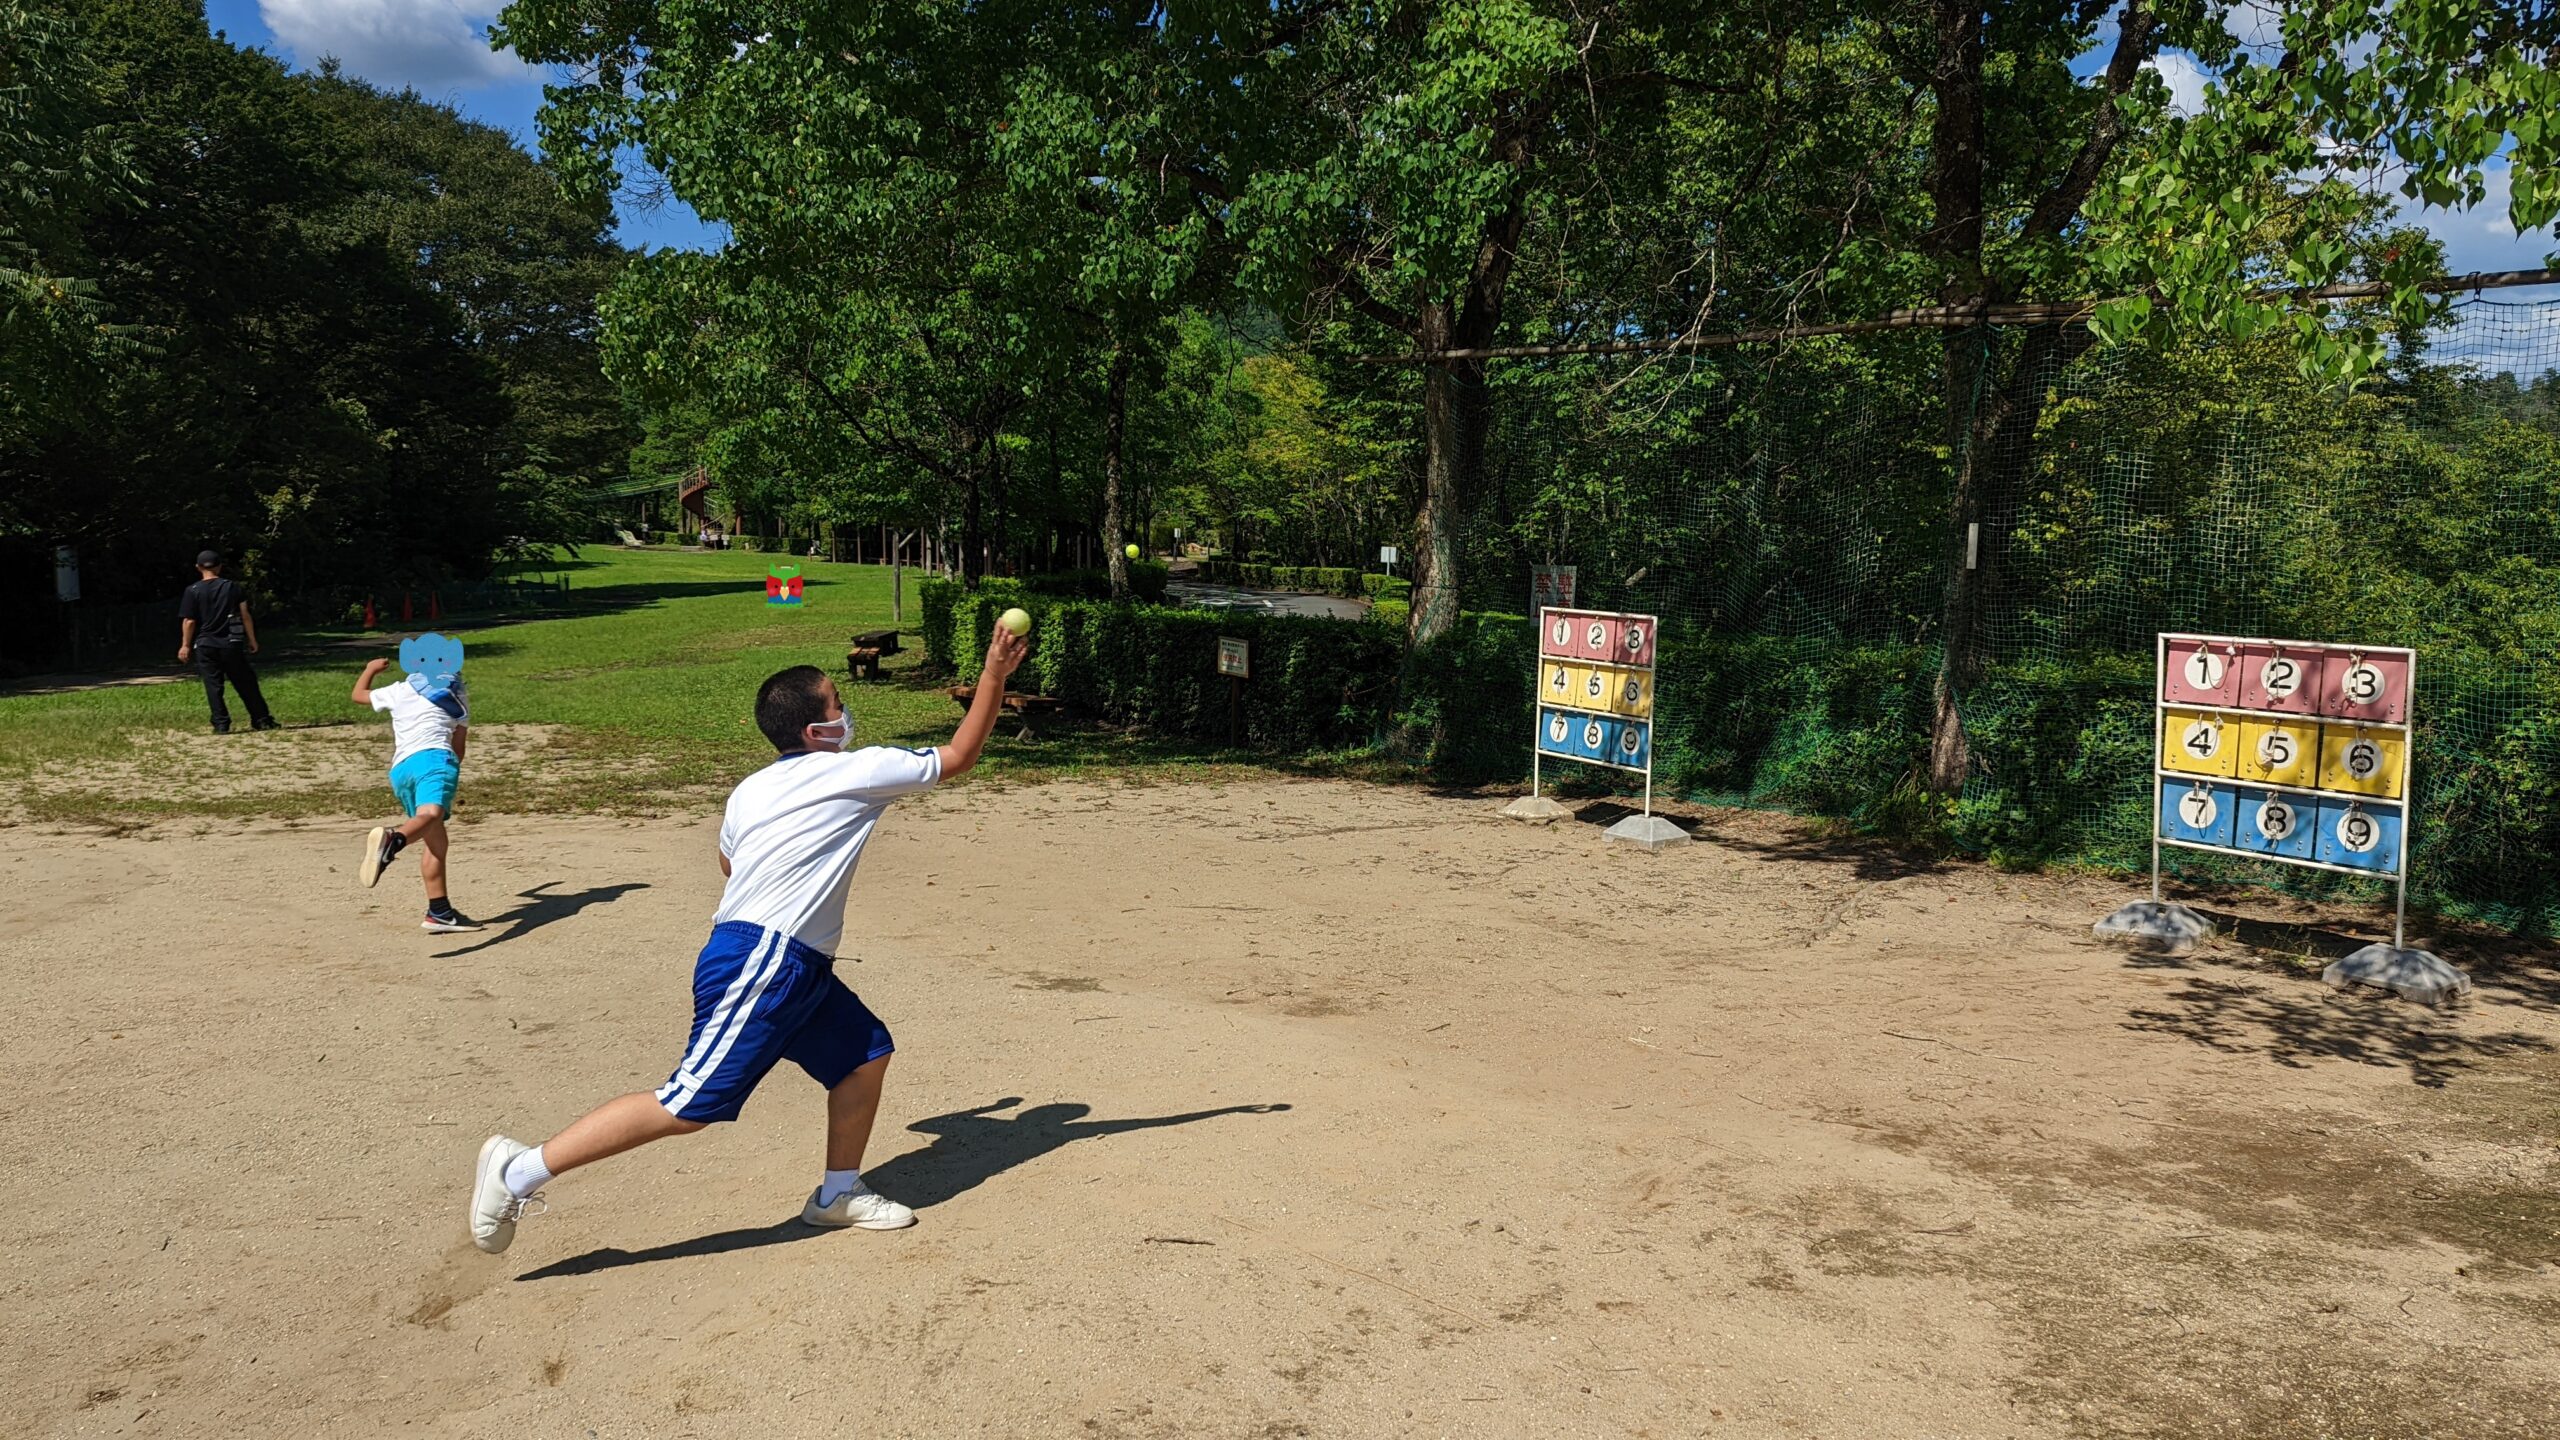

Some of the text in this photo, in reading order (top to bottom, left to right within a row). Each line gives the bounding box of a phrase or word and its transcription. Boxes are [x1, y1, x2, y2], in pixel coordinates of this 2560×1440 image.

[1558, 622, 1640, 648] 1 2 3
[1554, 671, 1638, 701] 4 5 6
[2197, 657, 2376, 698] 1 2 3
[1555, 720, 1637, 751] 7 8 9
[2187, 728, 2375, 773] 4 5 6
[2188, 797, 2371, 847] 7 8 9
